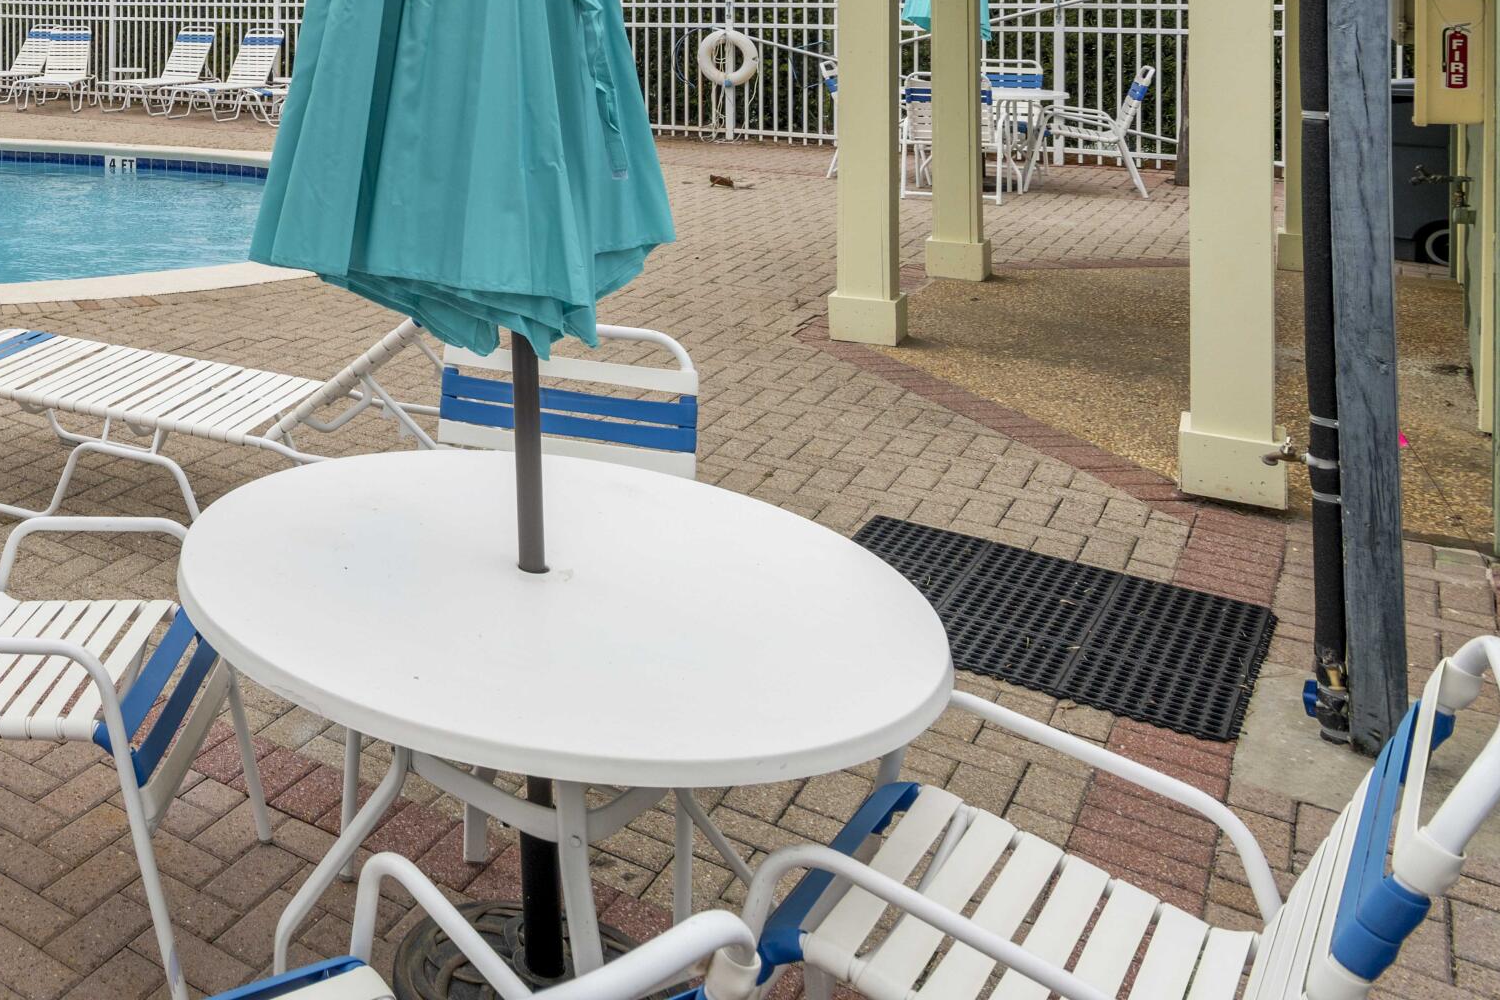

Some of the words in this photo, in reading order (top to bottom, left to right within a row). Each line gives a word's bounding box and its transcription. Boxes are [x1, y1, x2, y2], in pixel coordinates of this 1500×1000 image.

[1450, 39, 1464, 85] FIRE
[109, 158, 116, 171] 4
[121, 159, 134, 172] FT
